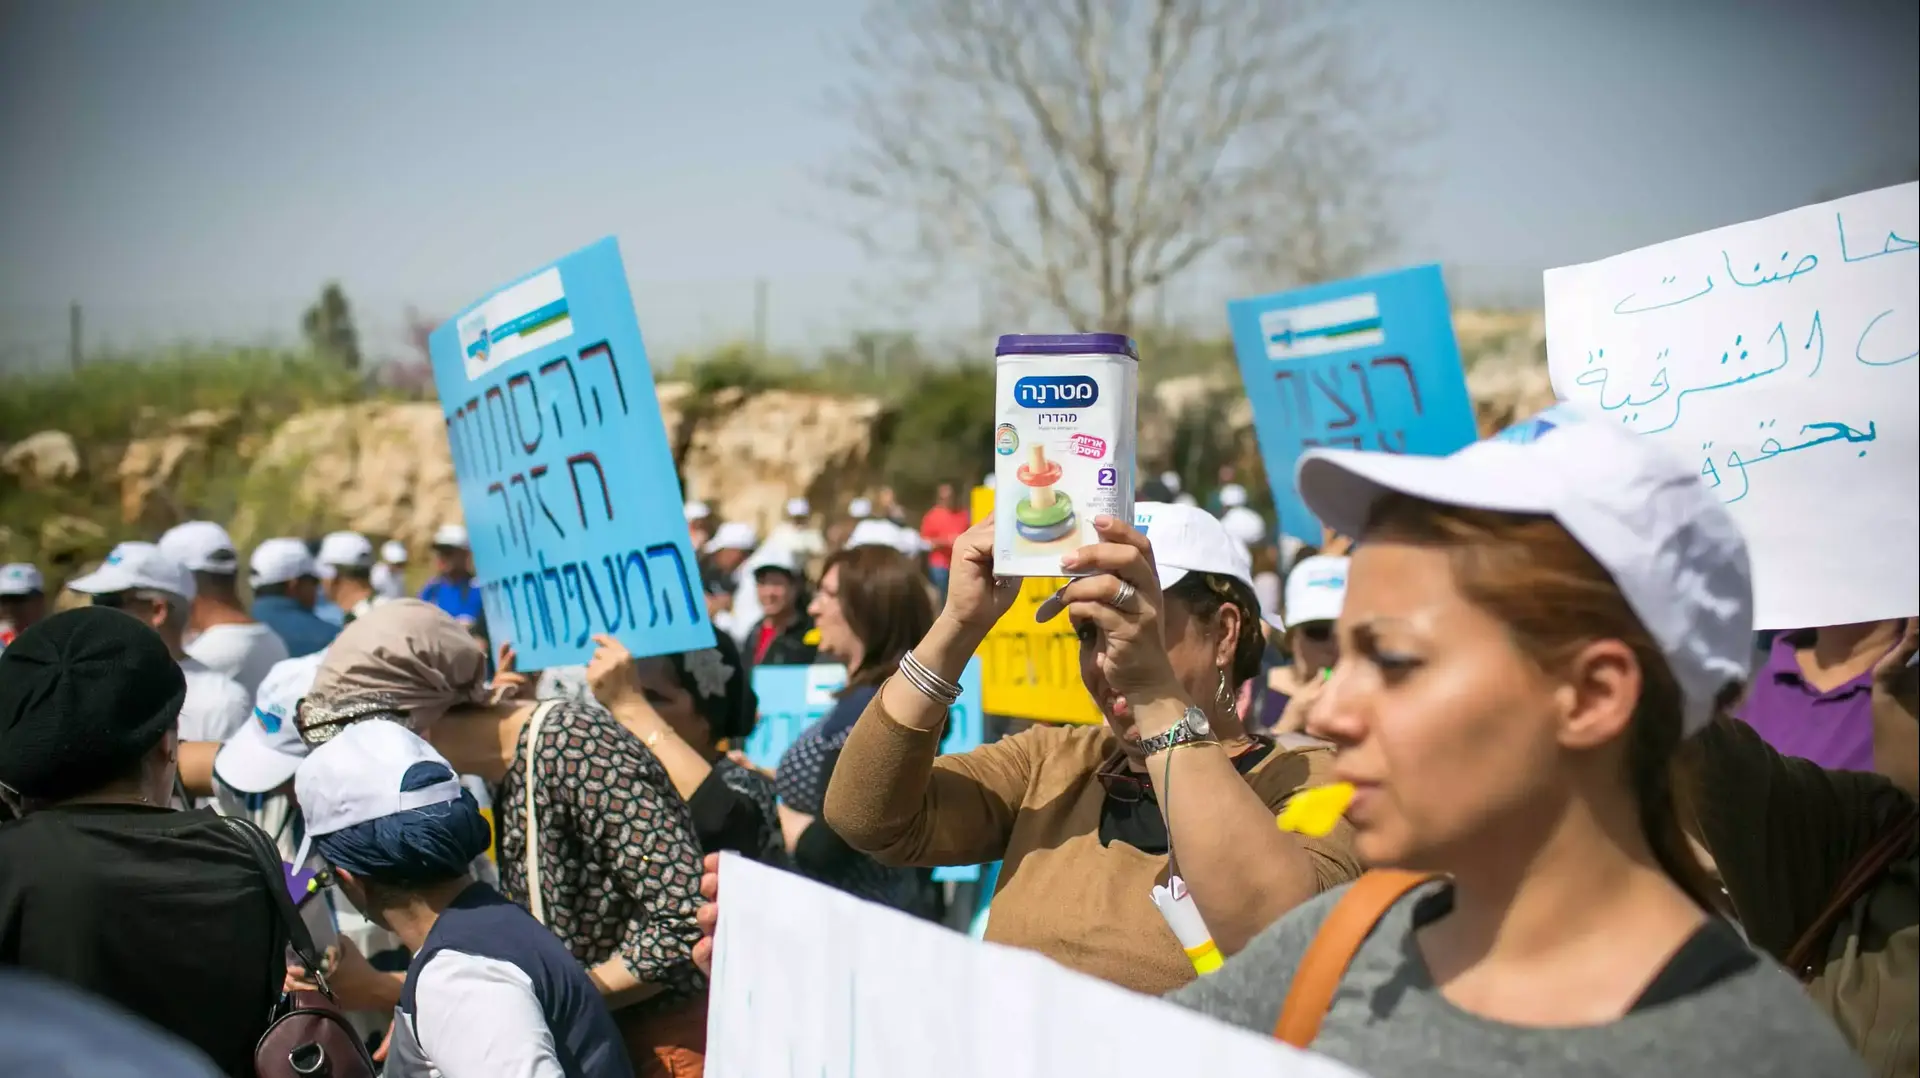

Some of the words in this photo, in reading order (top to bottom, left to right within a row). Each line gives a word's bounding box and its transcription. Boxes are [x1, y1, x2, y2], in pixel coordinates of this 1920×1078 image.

[1576, 310, 1824, 434] الشرقية
[1038, 413, 1077, 425] מהדרין
[1101, 470, 1113, 484] 2
